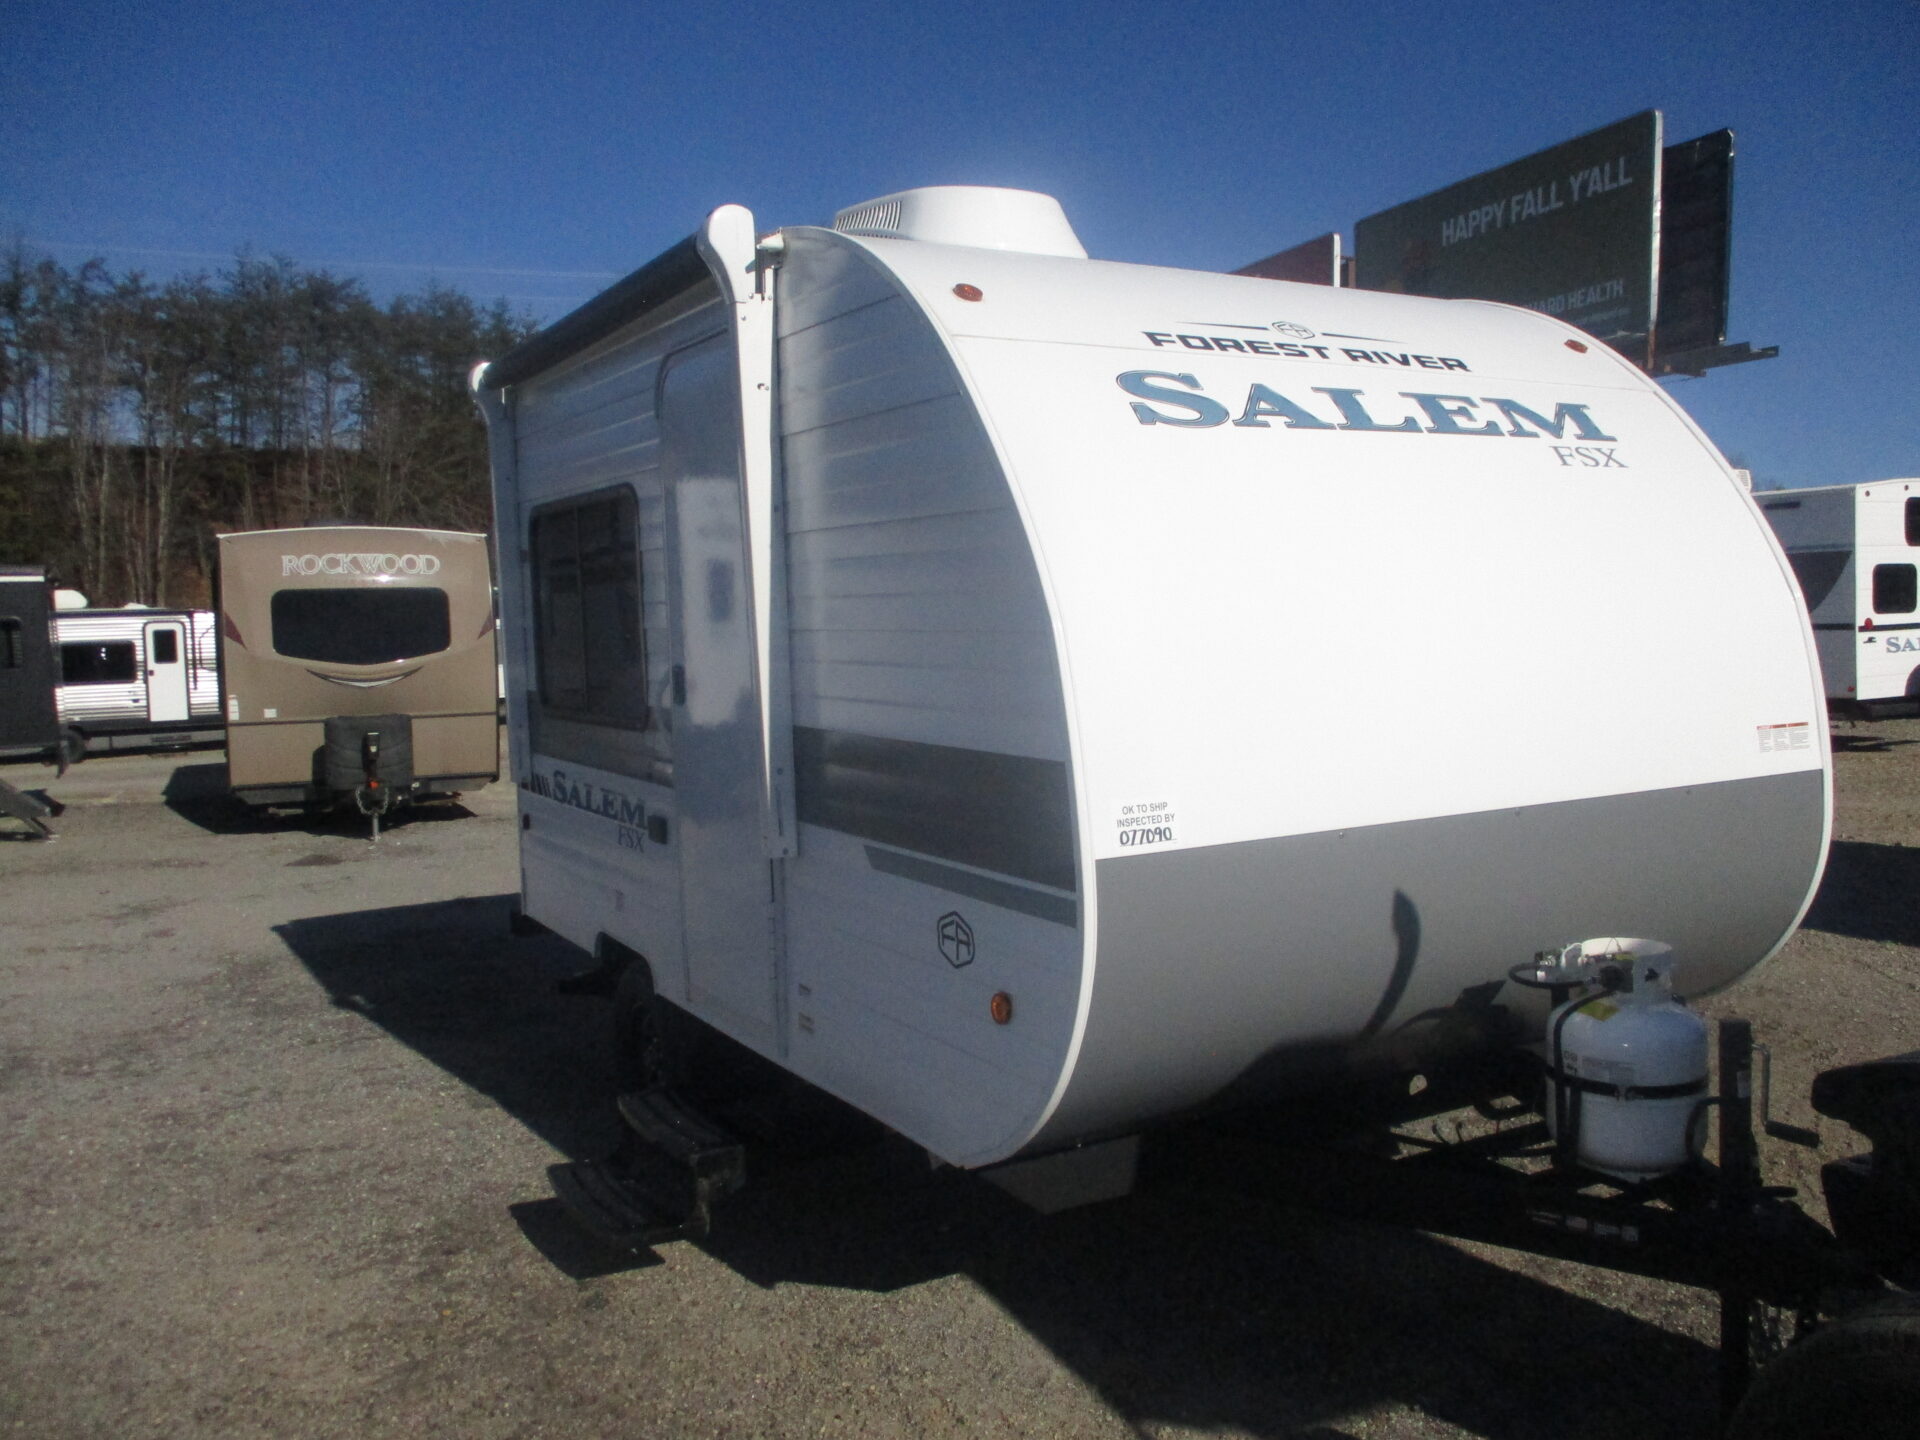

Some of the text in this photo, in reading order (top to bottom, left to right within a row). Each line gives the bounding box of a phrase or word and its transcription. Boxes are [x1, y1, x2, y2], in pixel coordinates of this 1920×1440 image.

[1441, 155, 1633, 247] HAPPY FALL Y'ALL
[1567, 278, 1624, 310] HEALTH
[1142, 331, 1472, 372] FOREST RIVER
[1116, 369, 1618, 442] SALEM
[1549, 445, 1629, 468] FSX
[281, 552, 441, 577] ROCKWOOD
[553, 770, 649, 831] SALEM
[1122, 801, 1168, 816] OK TO SHIP
[1116, 813, 1175, 828] INSPECTED BY
[618, 826, 644, 853] FSX
